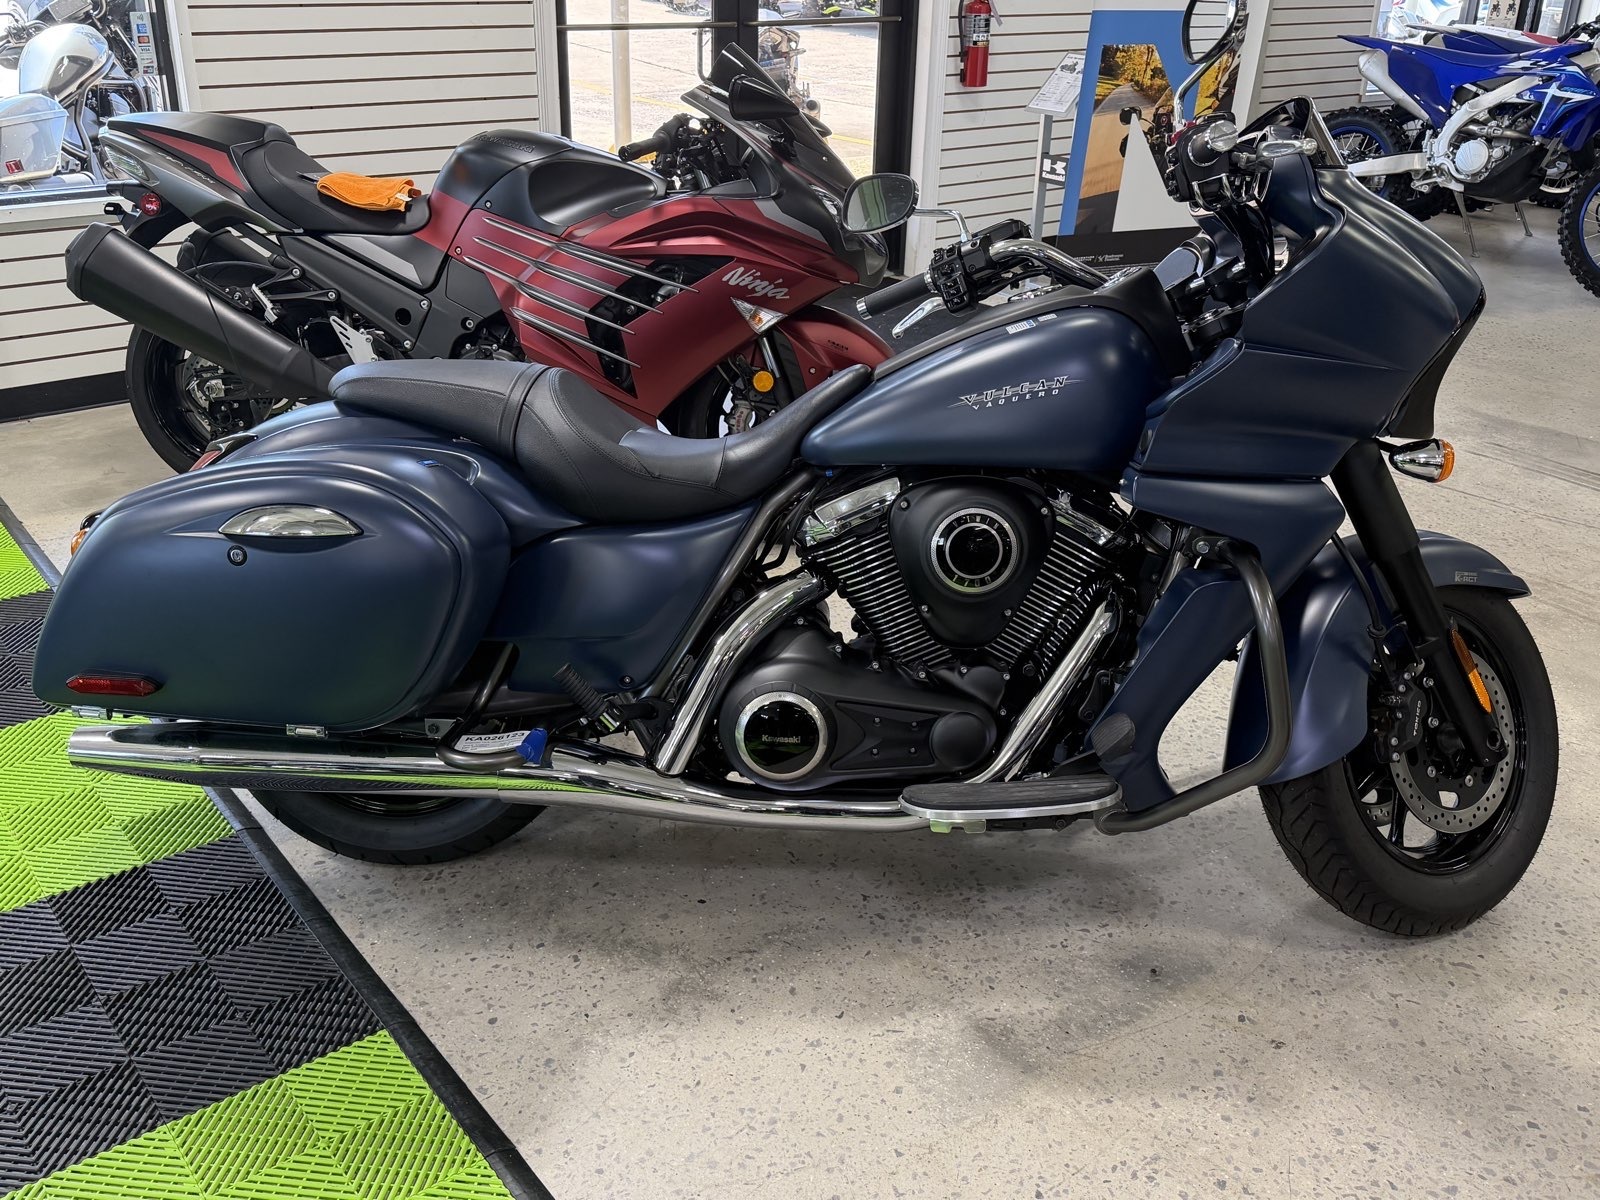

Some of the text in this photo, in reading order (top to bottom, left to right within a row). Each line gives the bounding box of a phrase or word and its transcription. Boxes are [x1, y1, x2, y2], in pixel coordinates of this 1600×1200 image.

[721, 266, 790, 300] Ninja
[959, 375, 1070, 406] VULCAN
[972, 388, 1059, 411] VAQUERO
[952, 574, 992, 588] 1700
[465, 732, 525, 742] KA026123
[761, 734, 801, 744] Kawasaki
